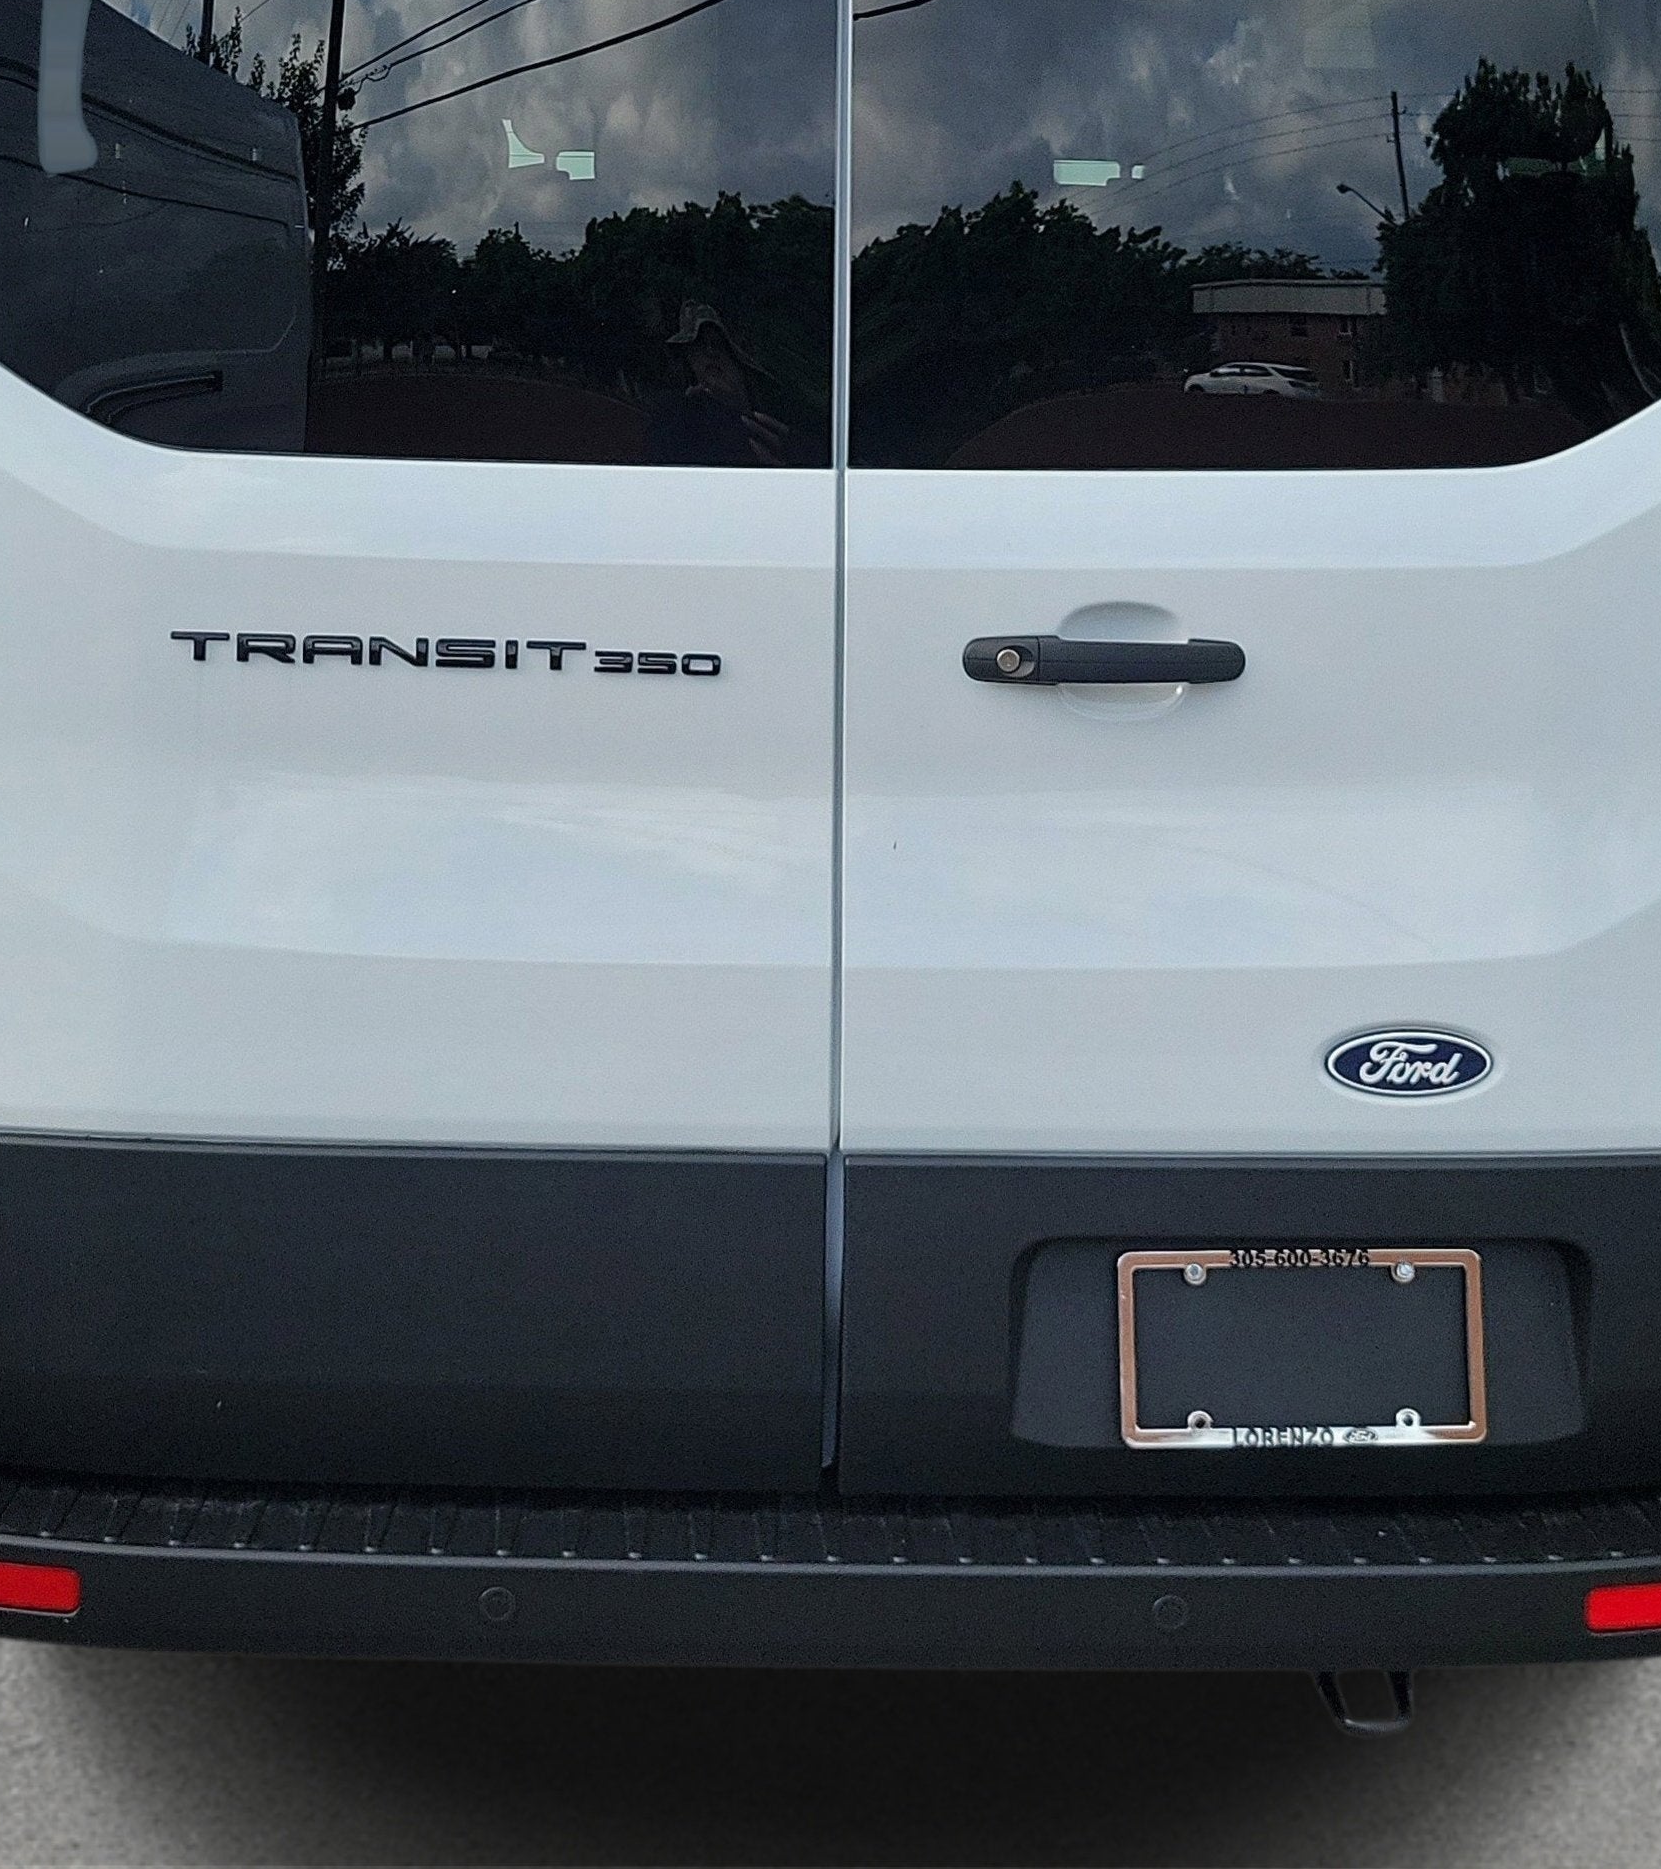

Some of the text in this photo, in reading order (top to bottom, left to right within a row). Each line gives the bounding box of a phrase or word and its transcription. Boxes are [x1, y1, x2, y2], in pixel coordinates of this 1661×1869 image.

[170, 630, 722, 676] TRANSIT 350
[1358, 1040, 1463, 1086] Ford
[1232, 1426, 1335, 1447] LORENZO
